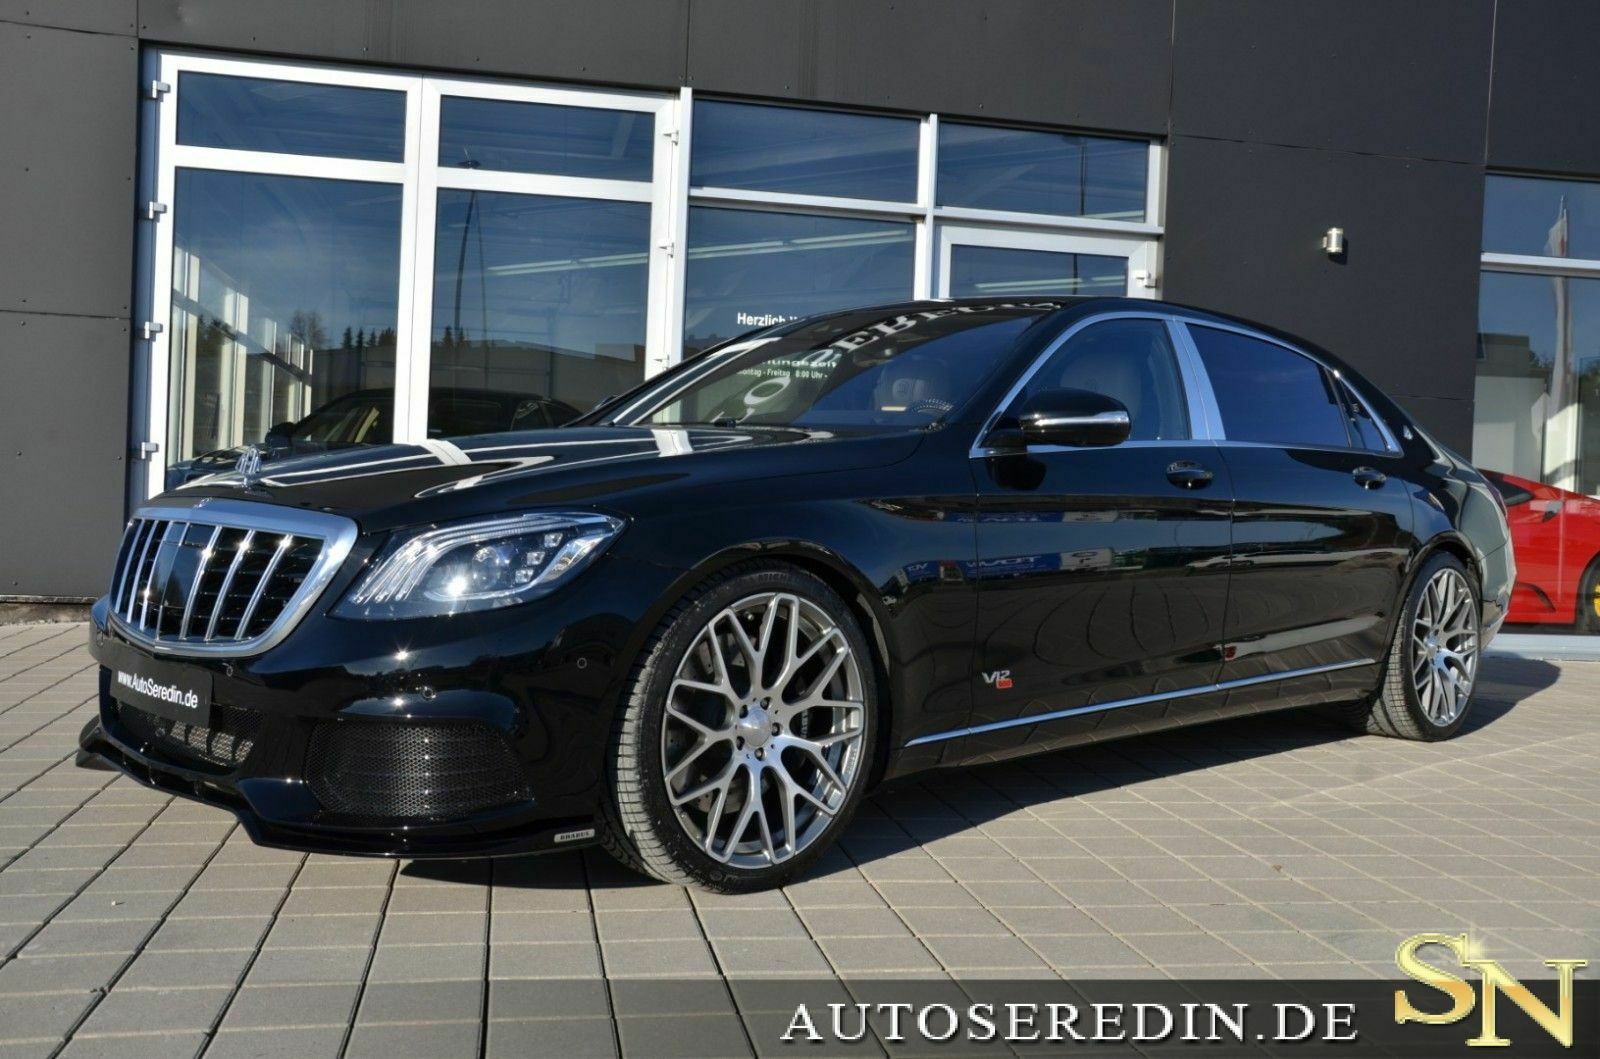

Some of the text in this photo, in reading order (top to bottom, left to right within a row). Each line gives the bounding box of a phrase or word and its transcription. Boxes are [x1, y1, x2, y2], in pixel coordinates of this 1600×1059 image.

[766, 368, 791, 378] Freitag
[811, 370, 824, 380] Uhr
[117, 670, 199, 709] www.AutoSeredin.de
